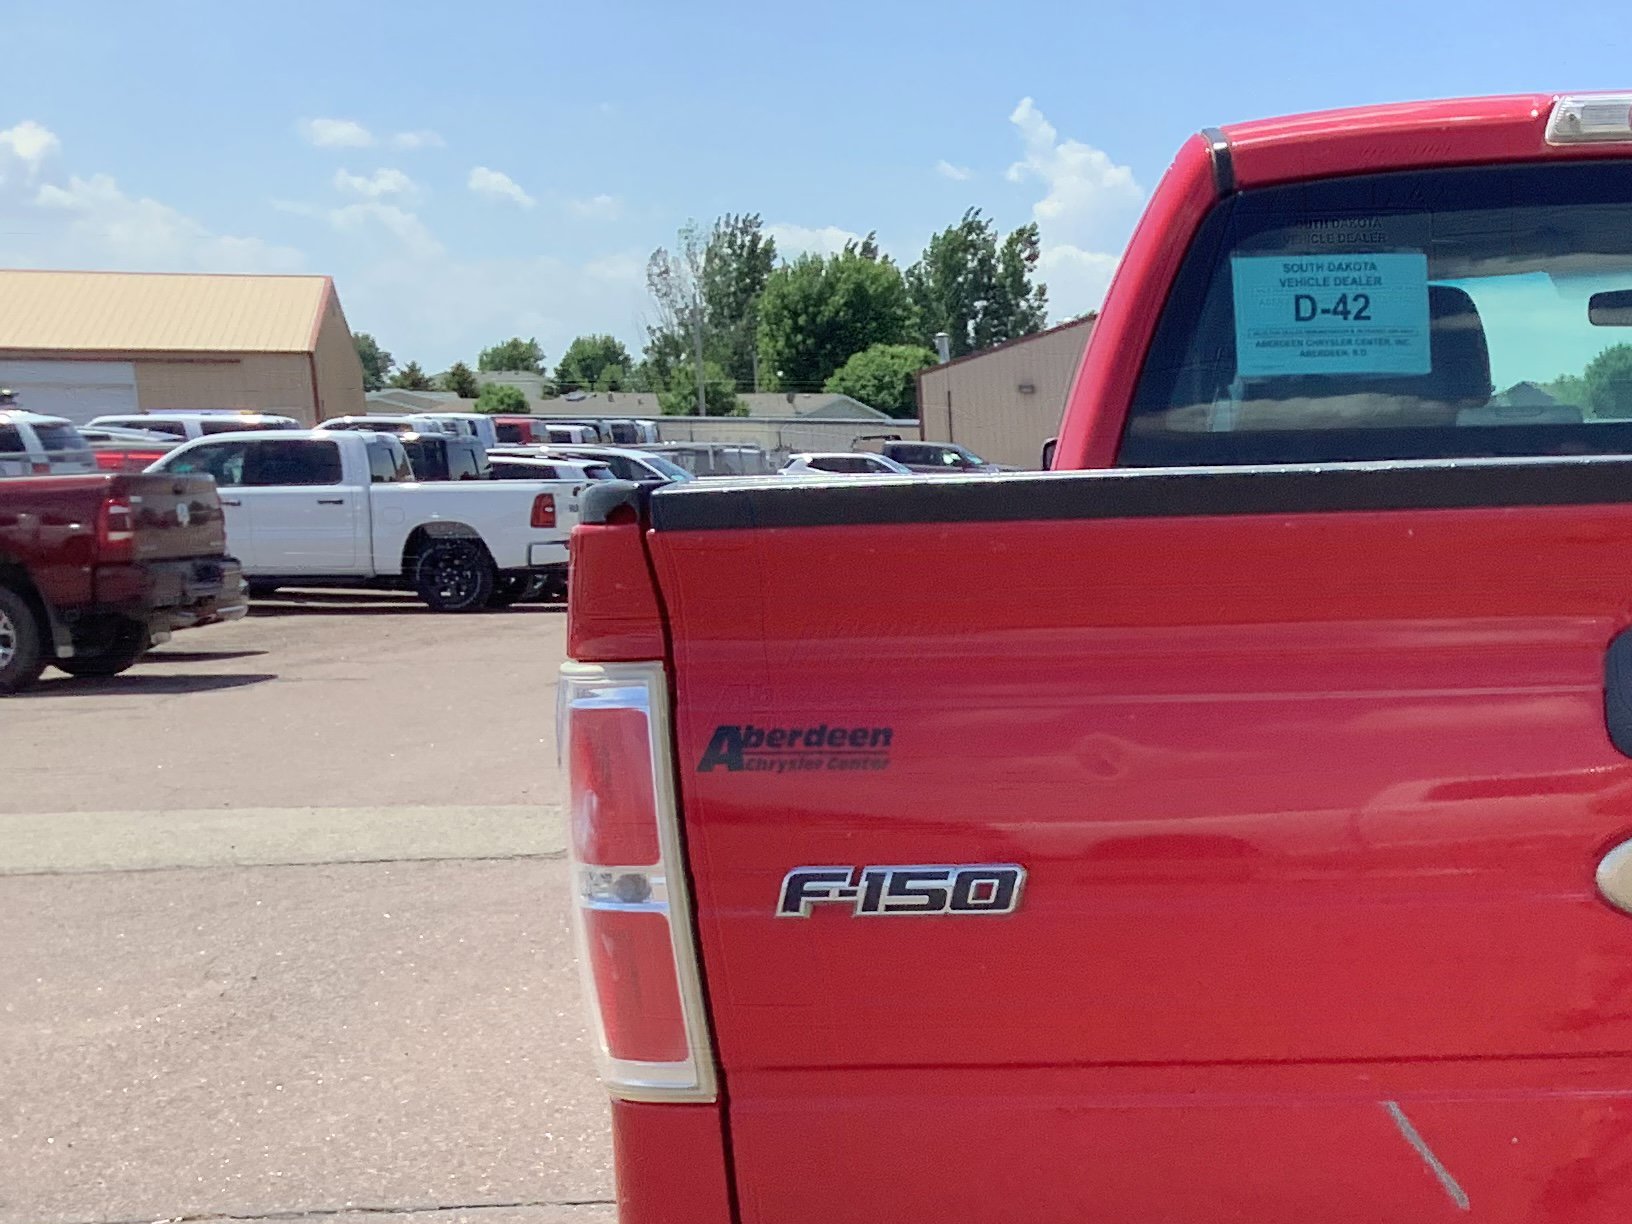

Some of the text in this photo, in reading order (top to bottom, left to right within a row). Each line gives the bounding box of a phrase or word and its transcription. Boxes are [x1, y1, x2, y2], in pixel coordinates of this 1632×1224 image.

[1283, 261, 1378, 273] SOUTH DAKOTA
[1279, 276, 1383, 288] VEHICLE DEALER
[1294, 293, 1372, 322] D-42
[1255, 339, 1304, 348] ABERDEEN
[1305, 339, 1353, 347] CHRYSLER
[695, 724, 894, 772] Aberdeen
[744, 757, 890, 773] Chrysler Center
[775, 863, 1028, 918] F-150
